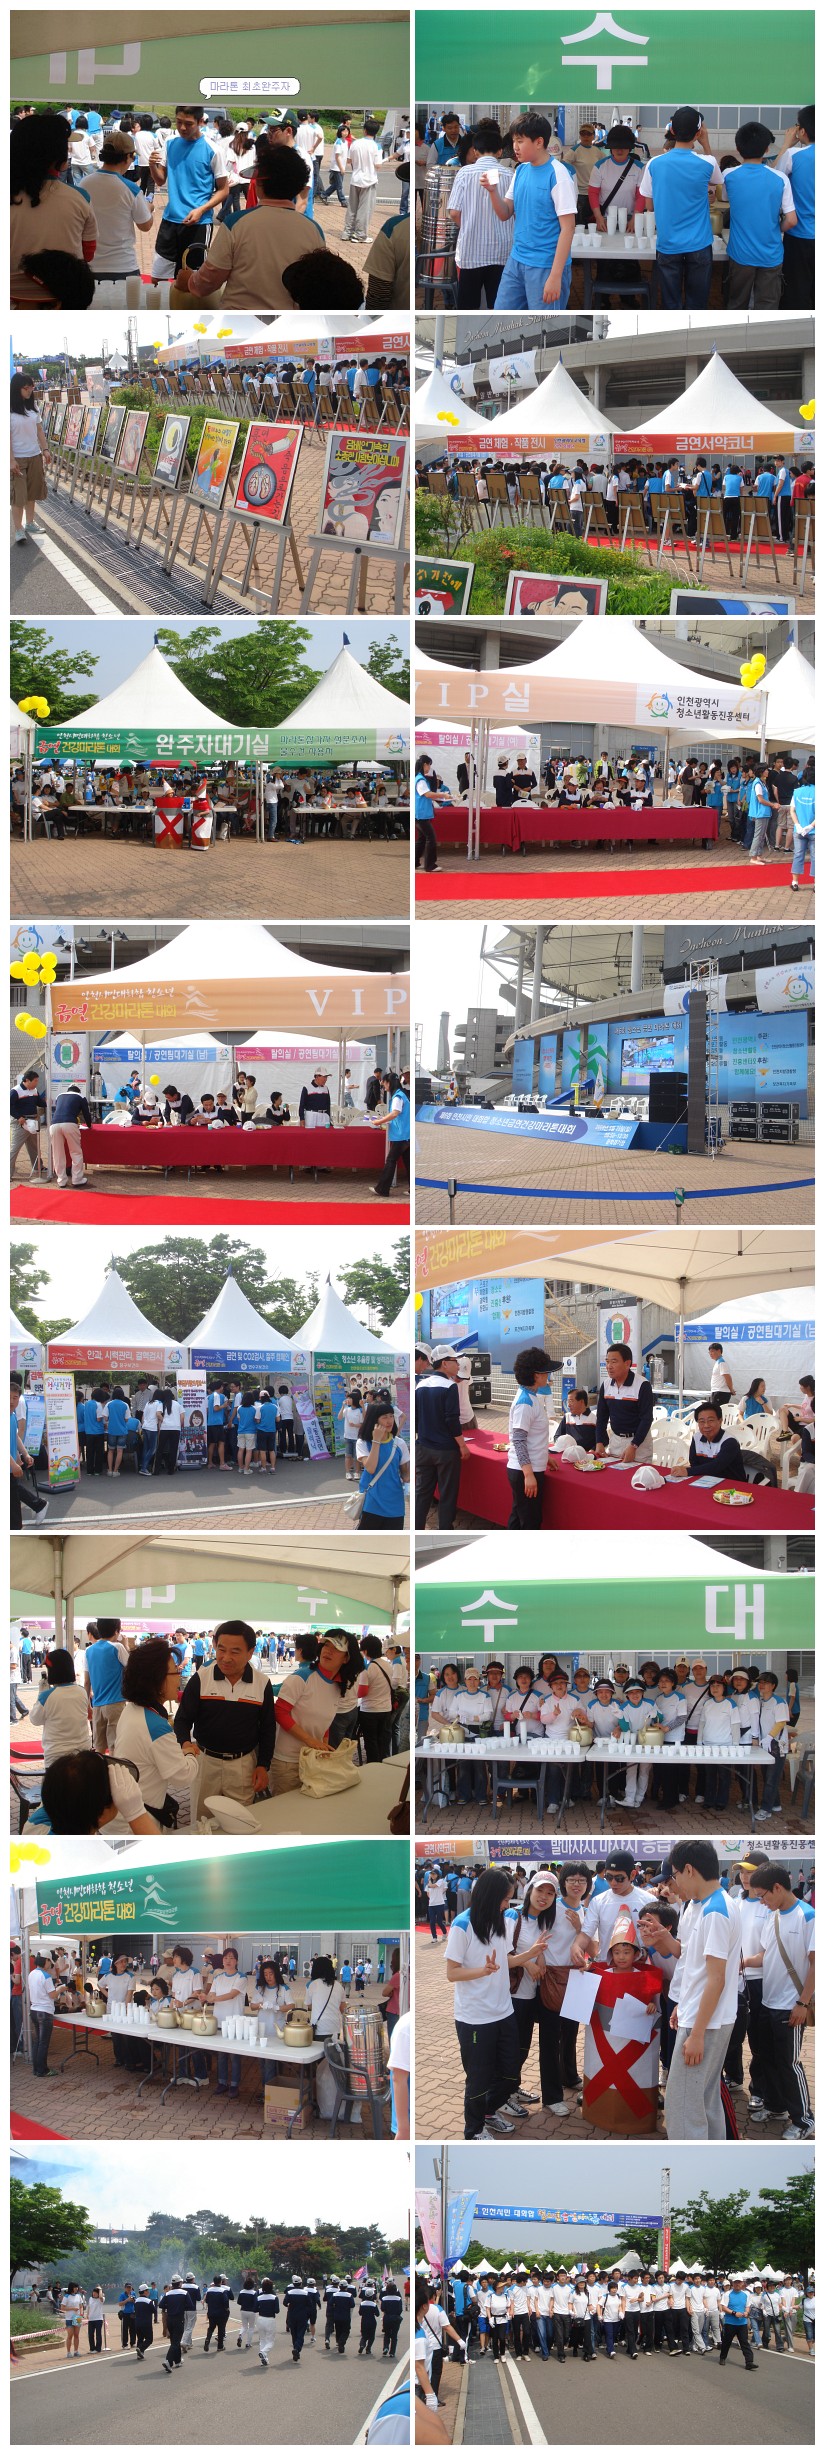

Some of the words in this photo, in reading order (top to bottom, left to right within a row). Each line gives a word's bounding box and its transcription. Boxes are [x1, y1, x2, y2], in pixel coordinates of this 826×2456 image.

[560, 12, 650, 90] 수
[479, 437, 493, 449] 금연
[494, 437, 508, 449] 체험
[514, 437, 528, 449] 작품
[531, 437, 546, 449] 전시
[676, 435, 754, 451] 금연서약코너
[677, 696, 719, 708] 인천광역시
[676, 707, 750, 723] 청소년활동진흥센터
[36, 740, 61, 754] 금연
[62, 741, 105, 754] 건강마라톤
[106, 745, 121, 754] 대회
[156, 734, 269, 756] 완주자대기실
[679, 938, 724, 954] Incheon
[726, 925, 785, 945] Munhak
[305, 988, 408, 1017] VIP
[55, 1002, 89, 1023] 금연
[90, 1001, 155, 1020] 건강마라톤
[156, 1004, 177, 1018] 대회
[127, 1050, 146, 1061] 탈의
[415, 1245, 429, 1278] 연
[429, 1230, 484, 1271] 건강마라톤
[715, 1325, 739, 1340] 탈의실
[747, 1324, 801, 1340] 공연팀대기실
[226, 1351, 237, 1361] 금연
[237, 1351, 243, 1361] 및
[341, 1355, 356, 1364] 청소년
[460, 1589, 519, 1643] 수
[704, 1584, 765, 1640] 대
[424, 1843, 456, 1855] 금연서약코너
[39, 1901, 63, 1926] 금연
[63, 1900, 116, 1923] 건강마라톤
[116, 1902, 136, 1921] 대회
[481, 2206, 511, 2217] 인천시민
[513, 2208, 535, 2218] 대화합
